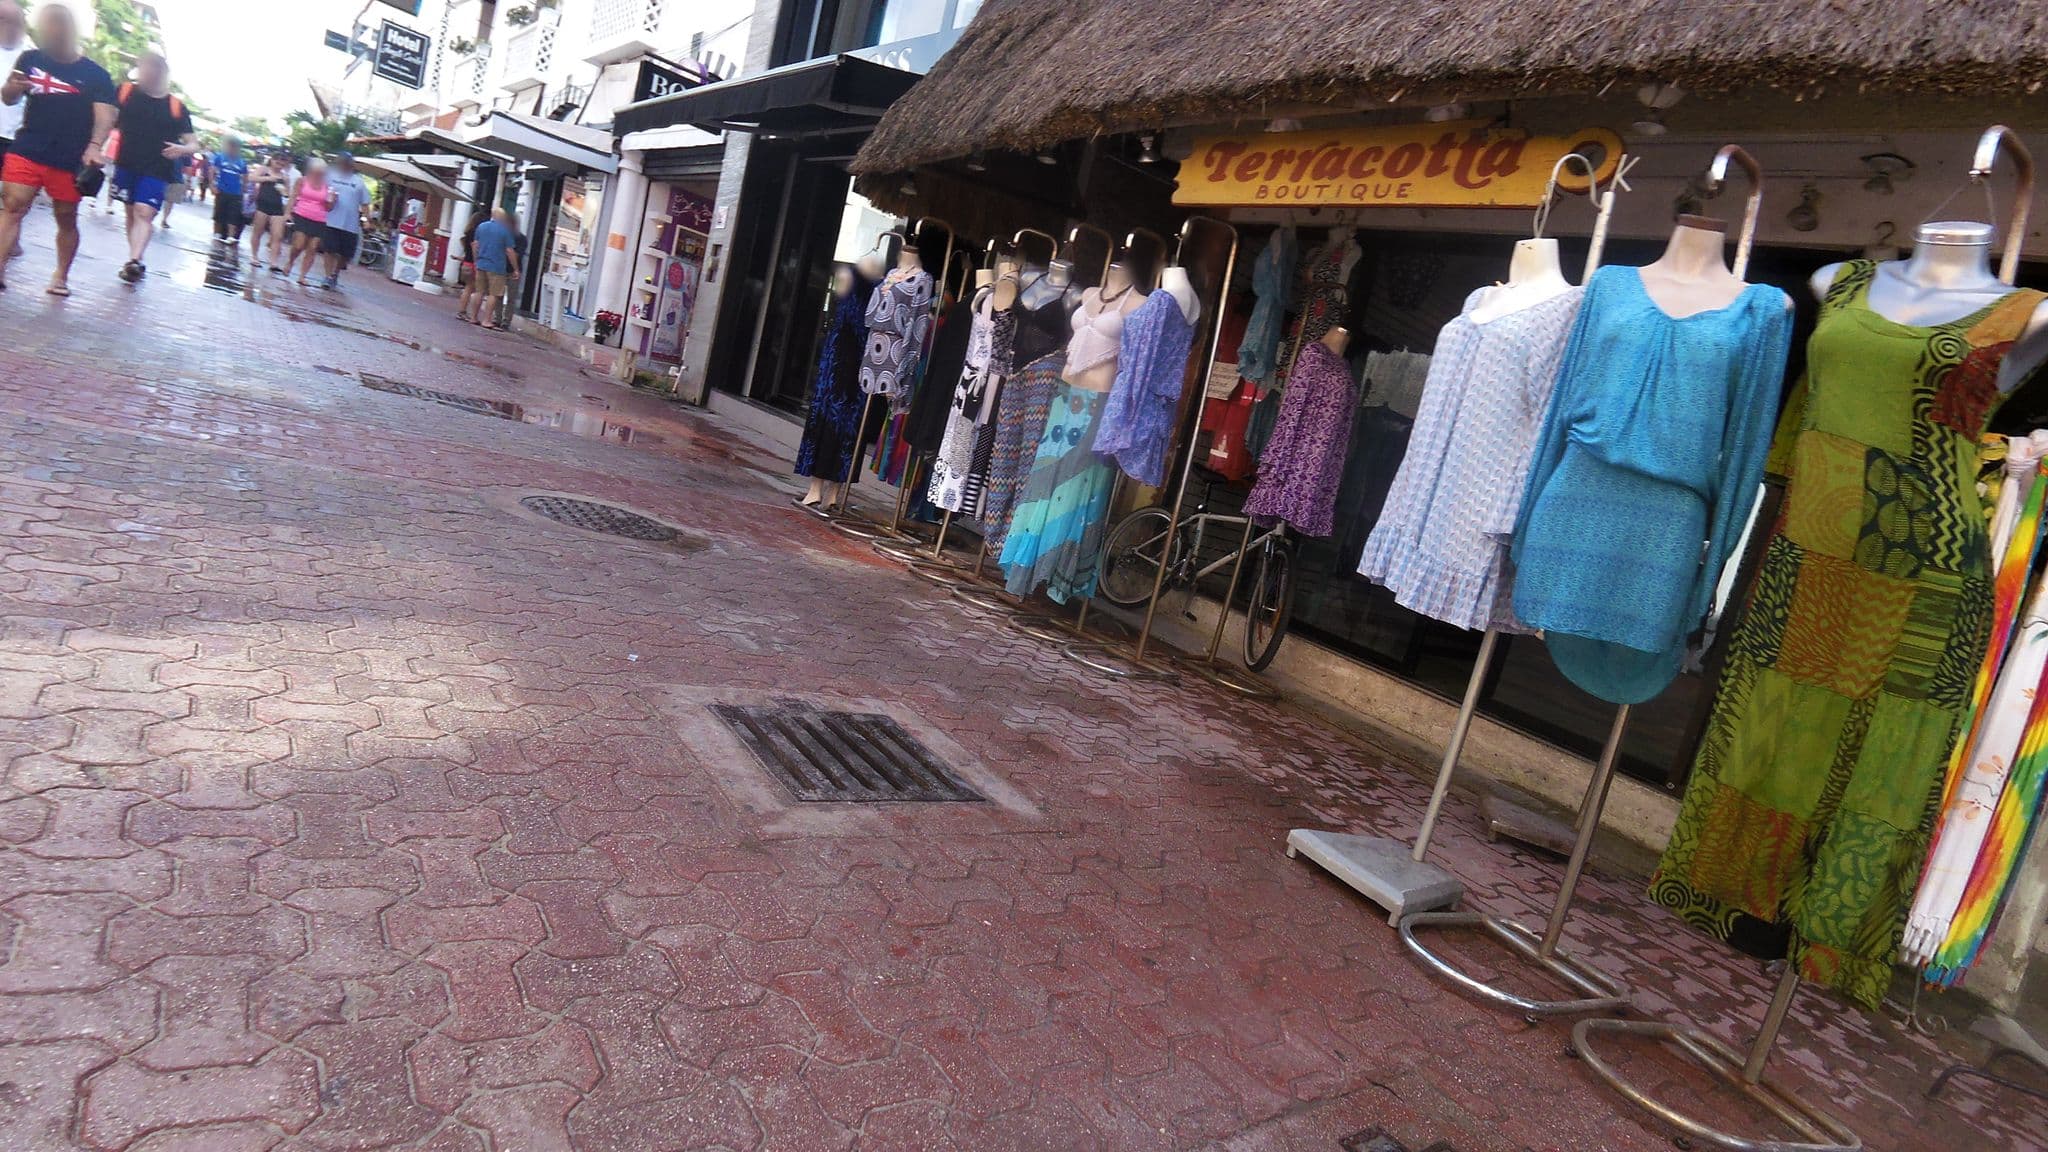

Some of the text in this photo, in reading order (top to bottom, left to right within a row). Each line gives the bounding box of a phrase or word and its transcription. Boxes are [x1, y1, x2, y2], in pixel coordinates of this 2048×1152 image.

[387, 29, 421, 52] Hotel
[1203, 131, 1534, 190] Terracotta
[1256, 182, 1412, 200] BOUTIQUE
[402, 240, 424, 253] ALTO
